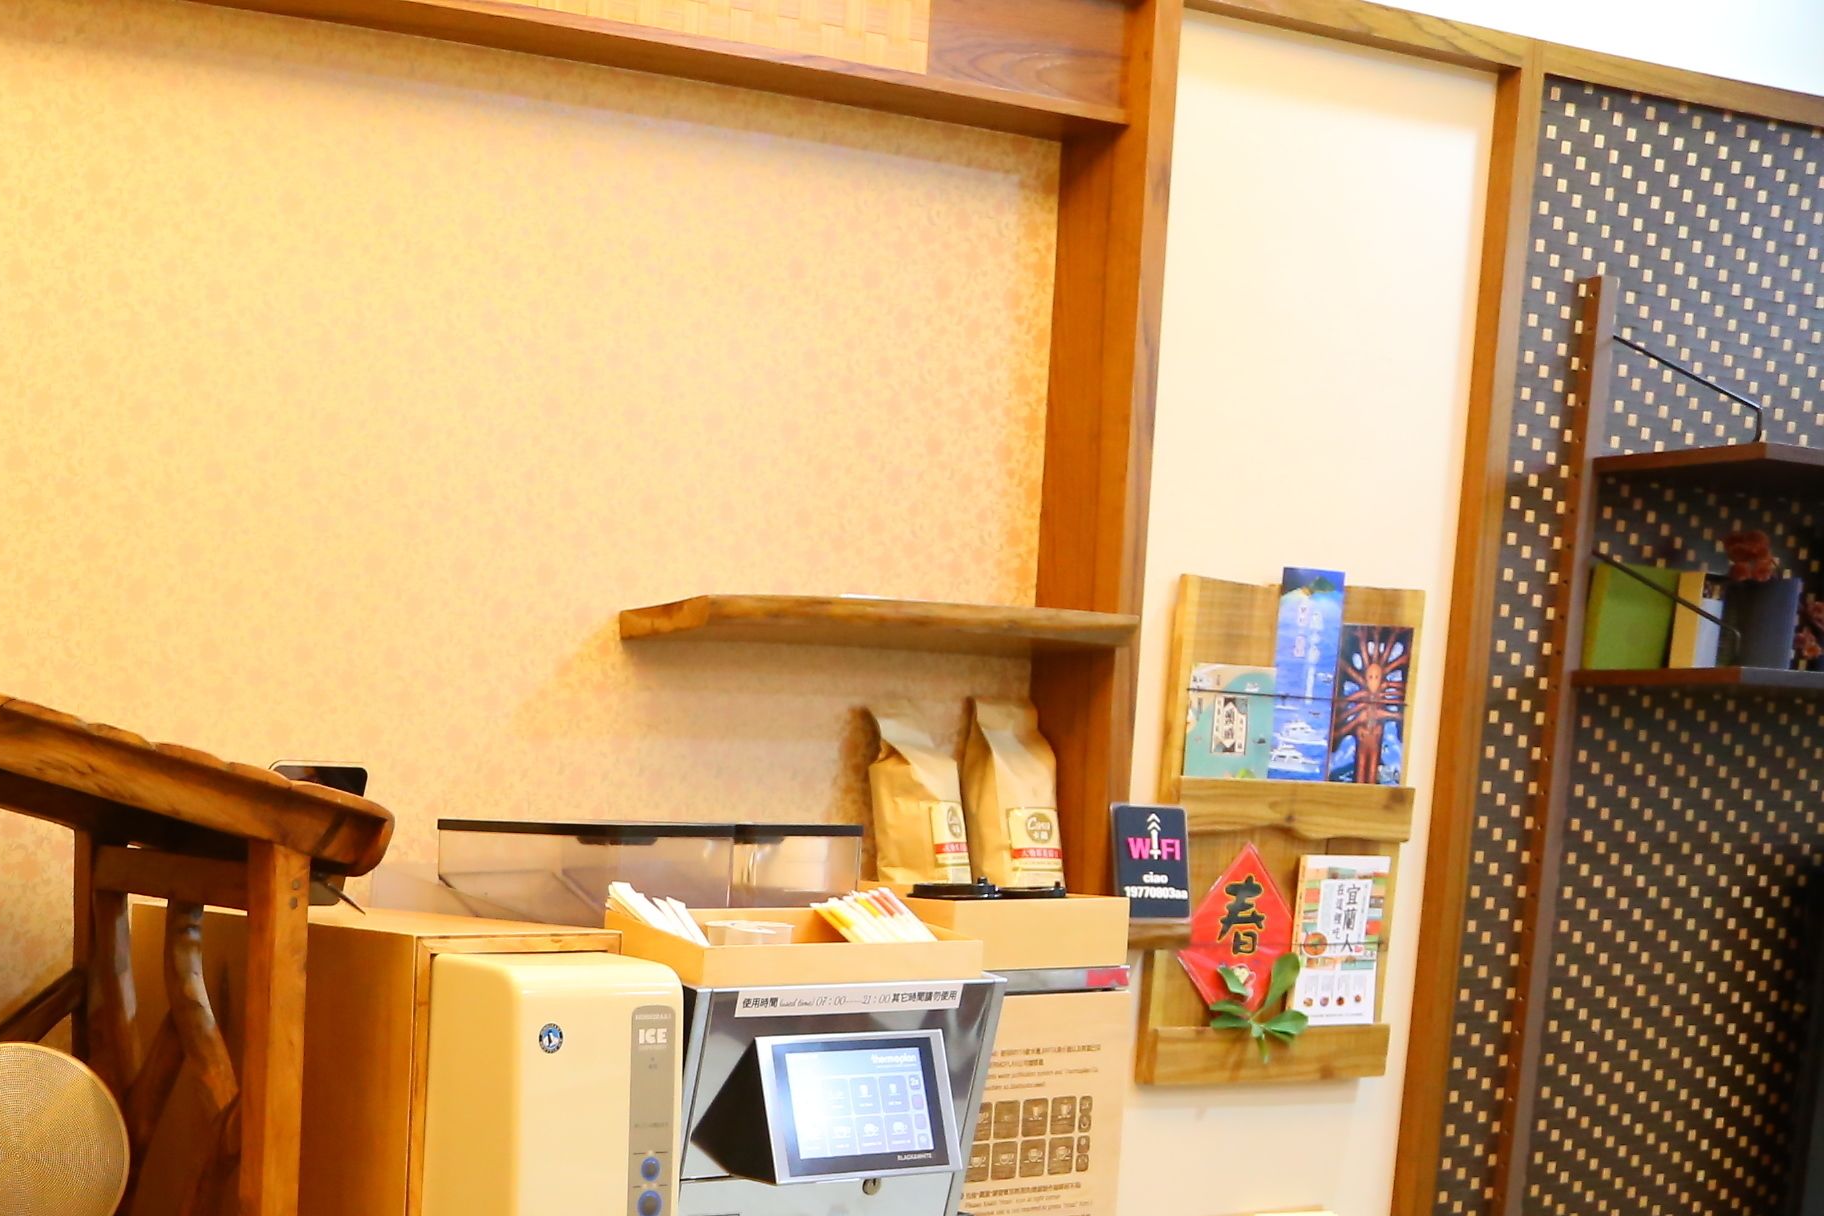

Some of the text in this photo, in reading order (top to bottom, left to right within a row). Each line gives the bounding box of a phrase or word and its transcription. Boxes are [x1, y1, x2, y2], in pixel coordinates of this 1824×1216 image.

[1142, 871, 1168, 884] ciao
[1124, 886, 1188, 899] 19770803aa
[1217, 875, 1265, 954] 春
[1341, 884, 1360, 952] 宜蘭人
[742, 997, 778, 1008] 使用時間
[639, 1028, 667, 1044] ICE
